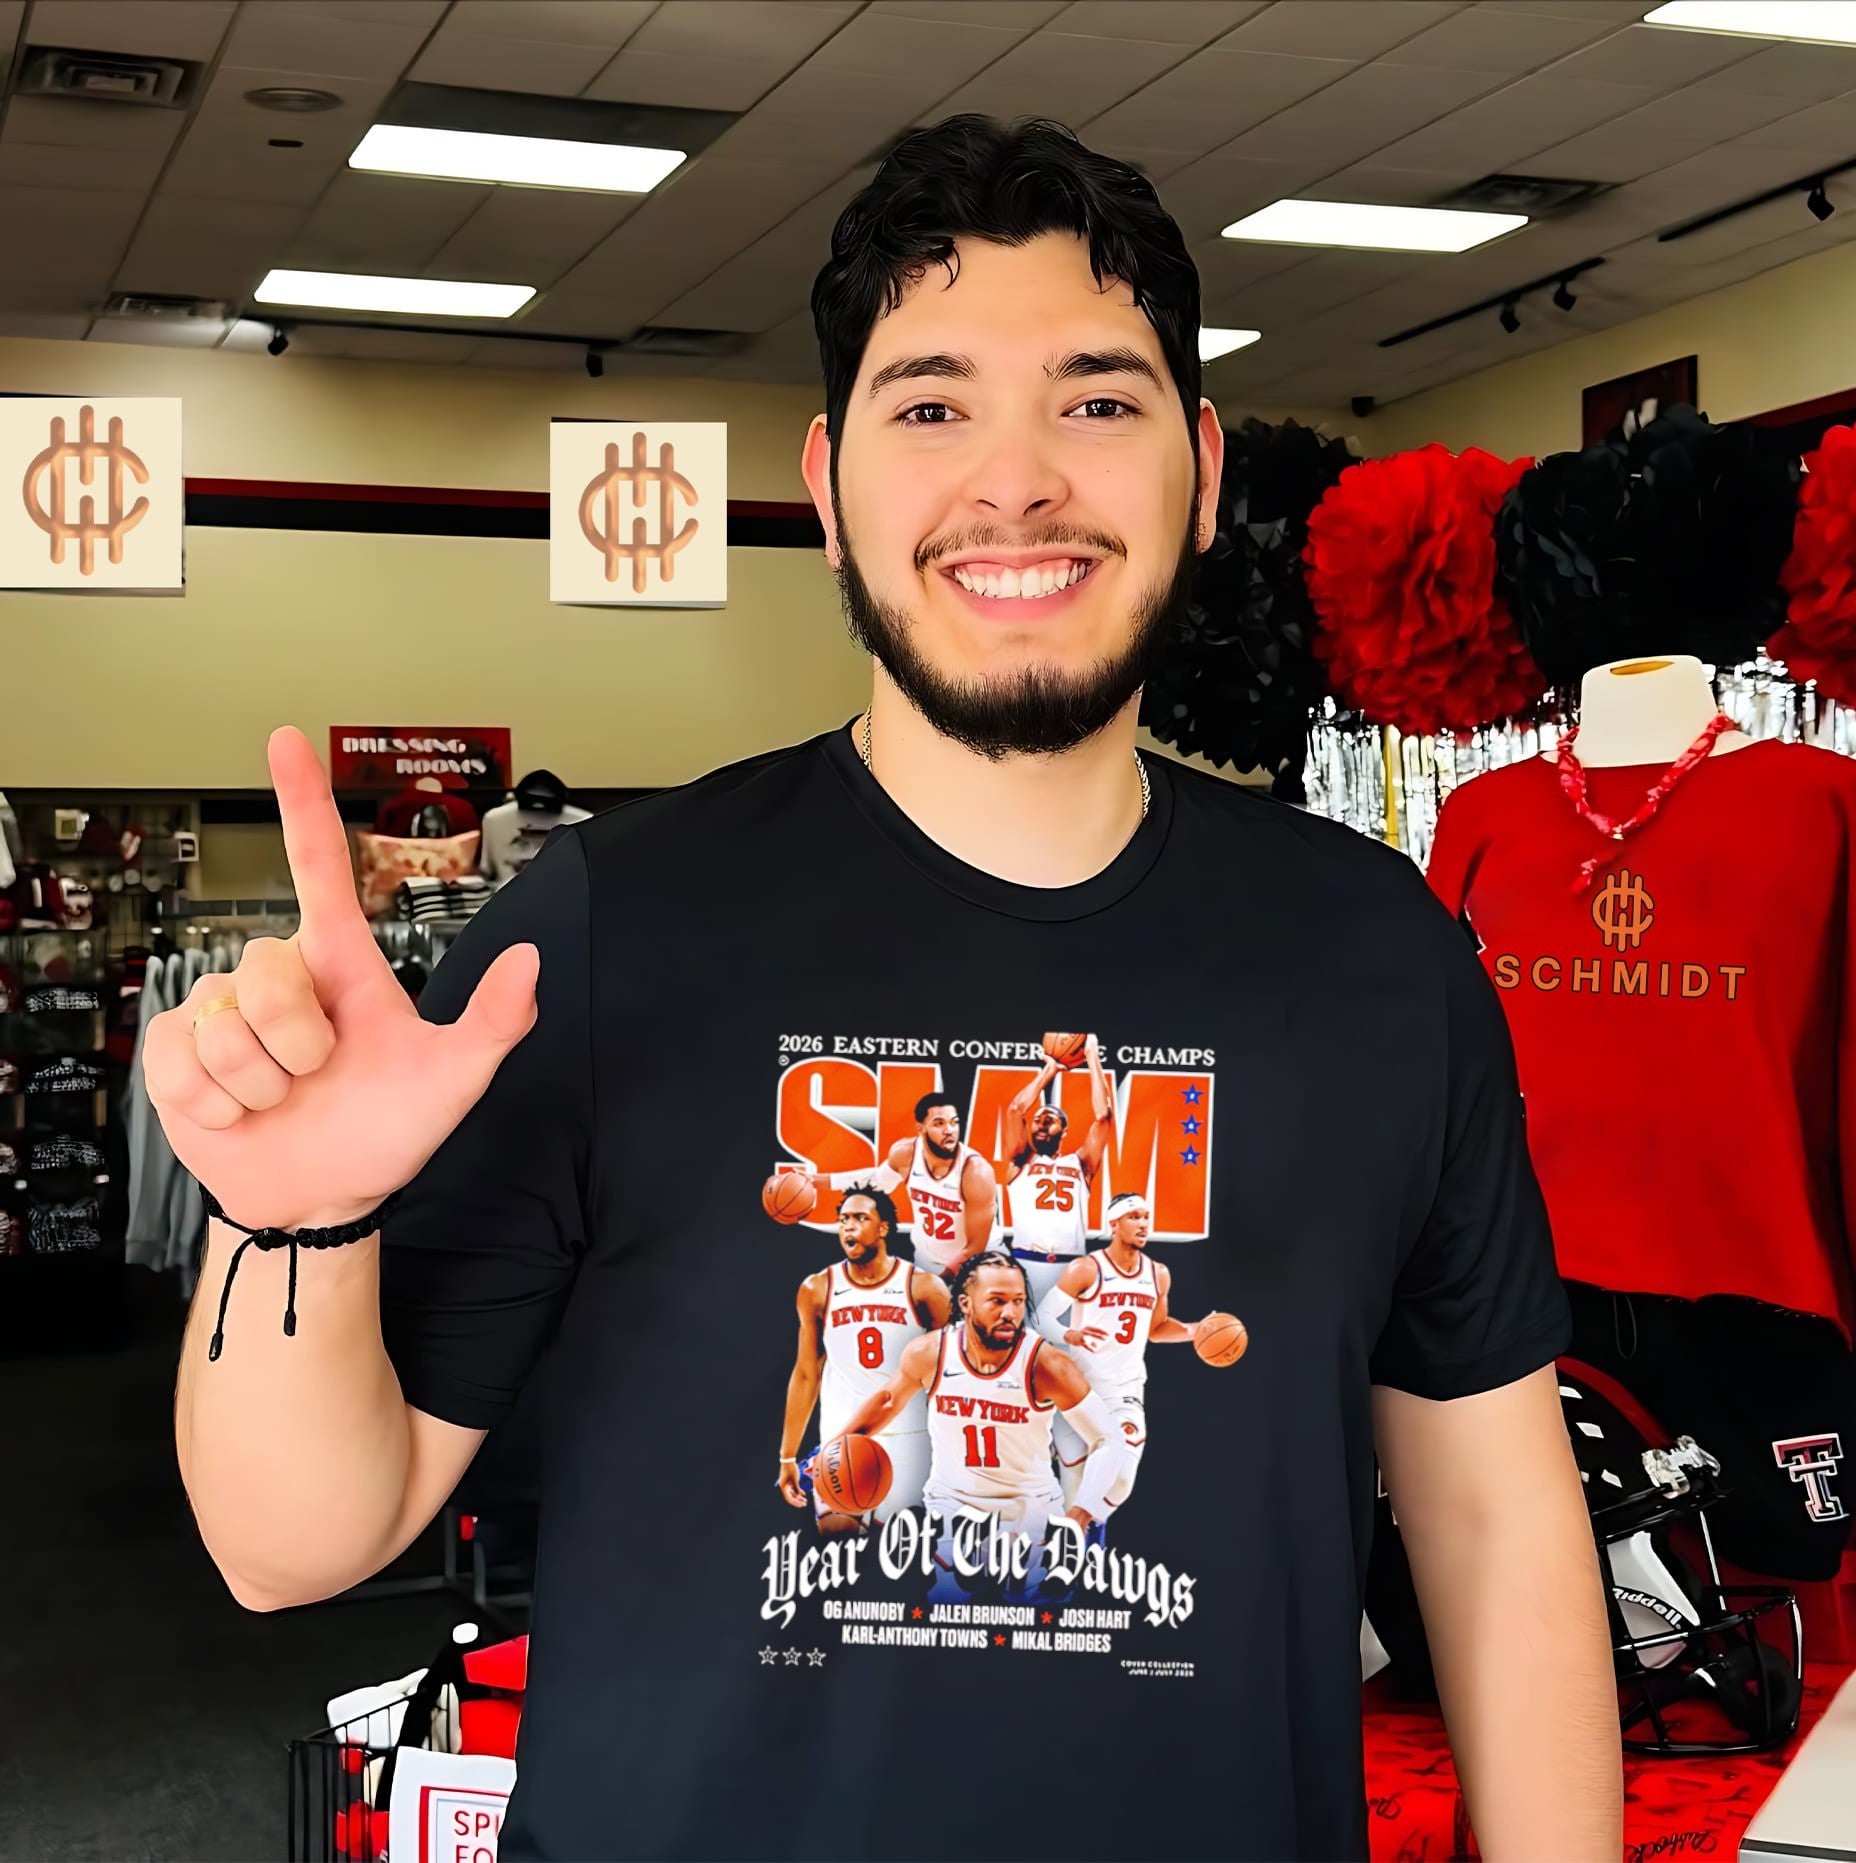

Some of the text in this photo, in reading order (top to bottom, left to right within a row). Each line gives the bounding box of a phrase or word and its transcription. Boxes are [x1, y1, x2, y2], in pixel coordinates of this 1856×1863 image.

[1494, 954, 1747, 1000] SCHMIDT
[779, 1034, 1216, 1066] 2026 EASTERN CONFERE CHAMPS
[1035, 1178, 1075, 1212] 25
[918, 1206, 955, 1239] 32
[1115, 1311, 1137, 1345] 3
[857, 1326, 884, 1369] 8
[935, 1395, 1030, 1423] NEW YORK
[963, 1424, 1000, 1467] 11
[761, 1504, 1197, 1630] Year Of The Dawgs
[823, 1600, 905, 1621] OG ANUNOBY
[929, 1603, 1035, 1626] JALEN BRUNSON
[1059, 1608, 1131, 1629] JOSH HART
[842, 1625, 988, 1648] KARL-ANTHONY TOWNS
[1011, 1630, 1111, 1653] MIKAL BRIDGES
